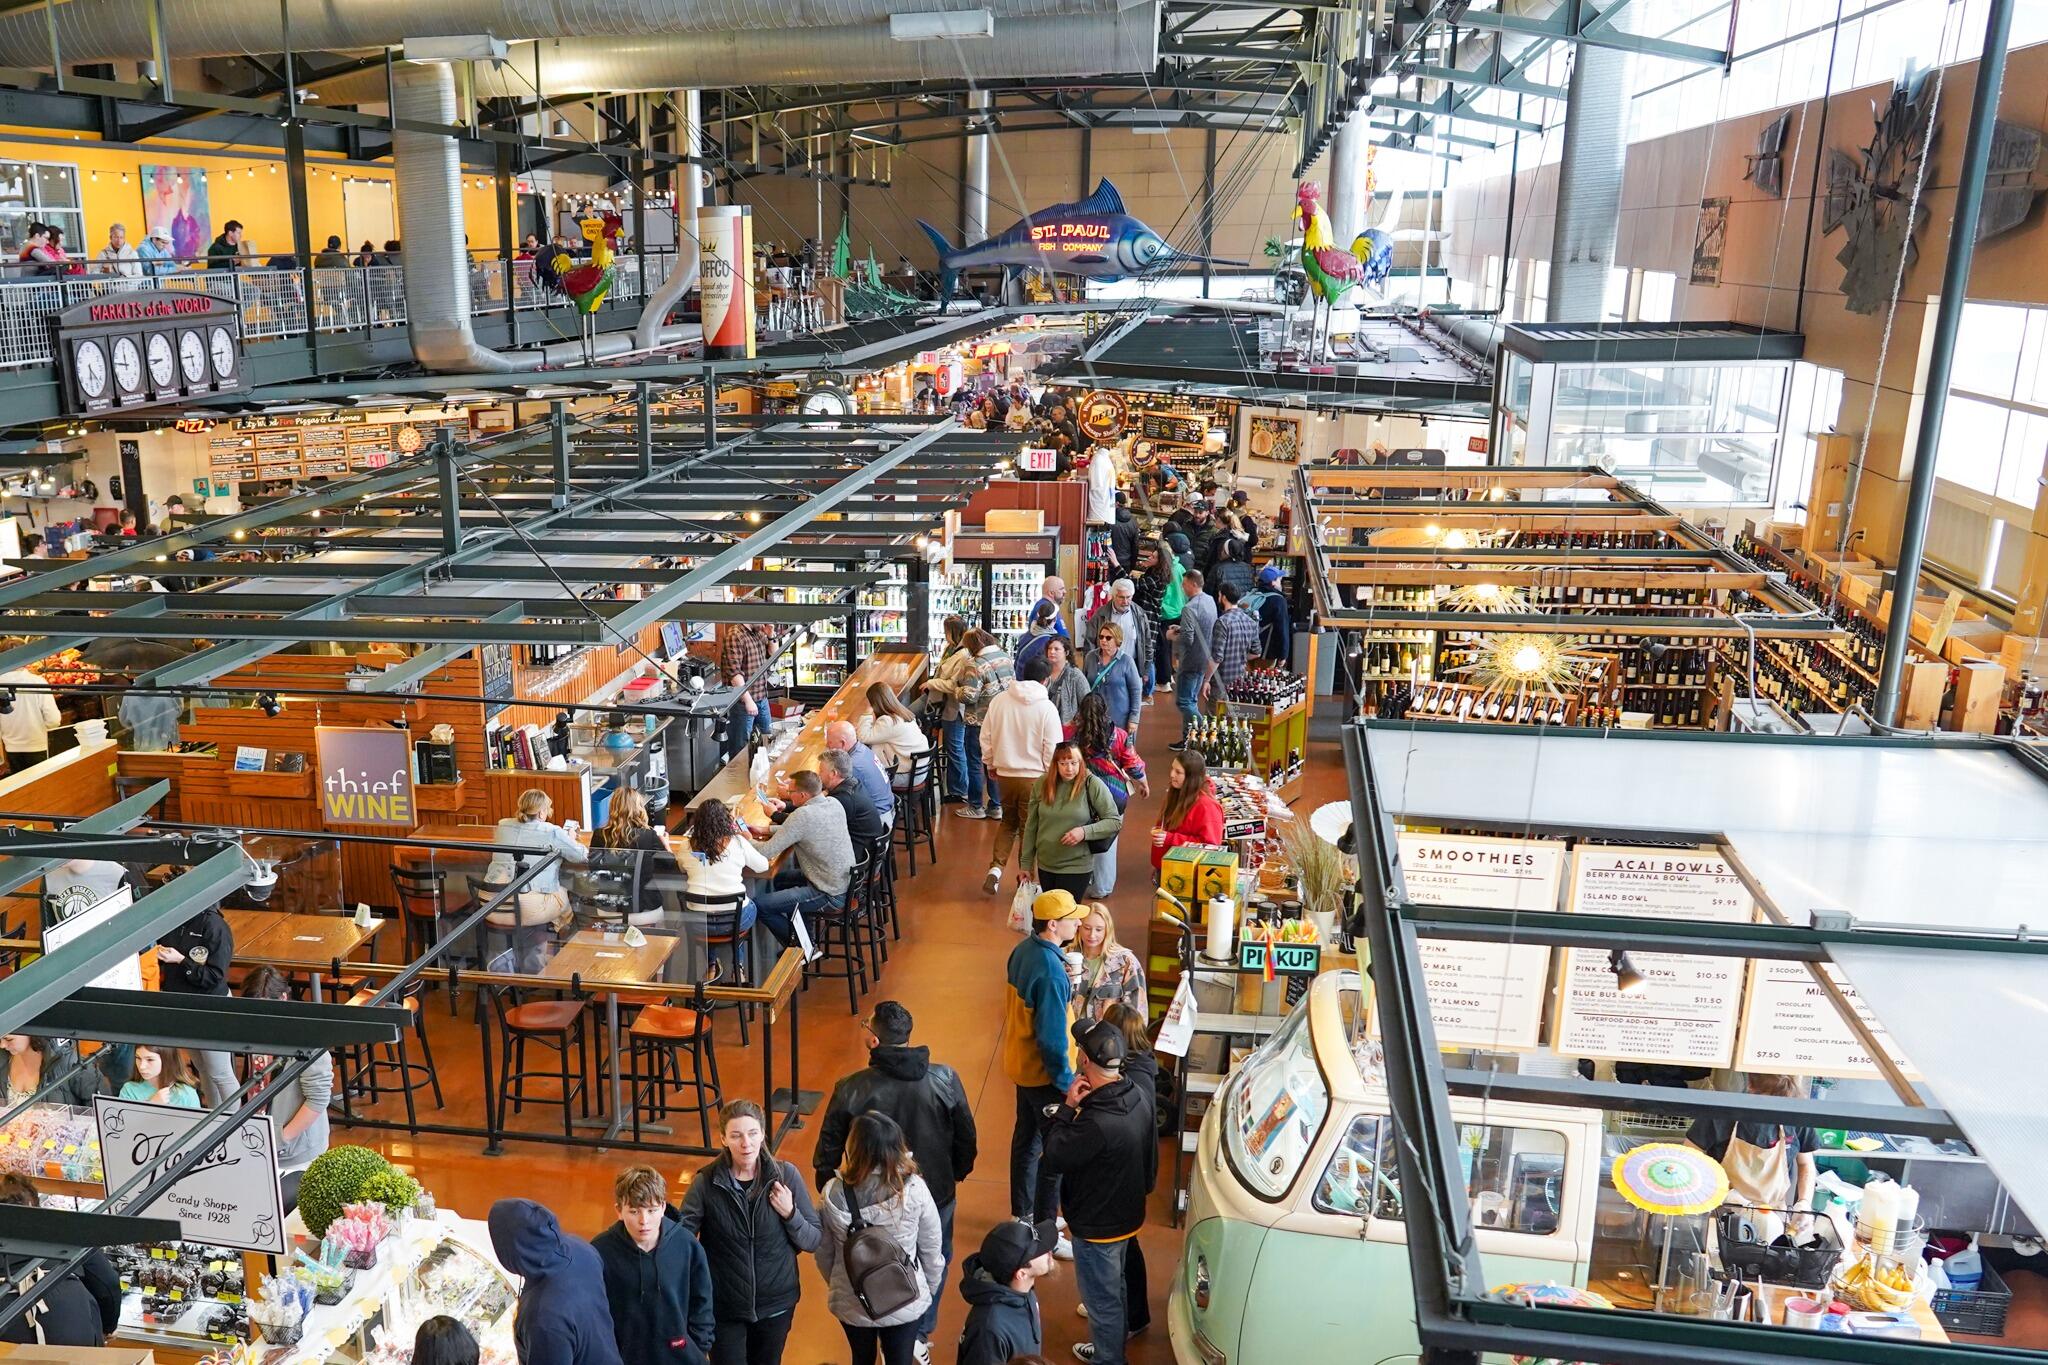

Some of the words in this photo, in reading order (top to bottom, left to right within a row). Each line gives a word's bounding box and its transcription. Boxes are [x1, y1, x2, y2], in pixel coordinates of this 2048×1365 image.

[1031, 225, 1057, 239] ST.
[1061, 224, 1110, 238] PAUL
[1062, 244, 1103, 252] COMPANY
[91, 302, 144, 321] MARKETS
[146, 305, 154, 316] of
[157, 302, 172, 316] the
[174, 298, 212, 314] WORLD
[1092, 408, 1116, 424] DELI
[368, 454, 386, 468] EXIT
[1031, 452, 1052, 468] EXIT
[325, 767, 406, 794] thief
[326, 792, 410, 821] WINE
[1418, 848, 1534, 866] SMOOTHIES
[1614, 860, 1655, 871] ACAI
[1664, 862, 1724, 874] BOWLS
[1246, 949, 1314, 967] PIKUP
[1433, 963, 1462, 971] MAPLE
[168, 1192, 200, 1208] Candy
[203, 1198, 238, 1212] Shoppe
[178, 1208, 202, 1220] Since
[207, 1212, 231, 1224] 1928
